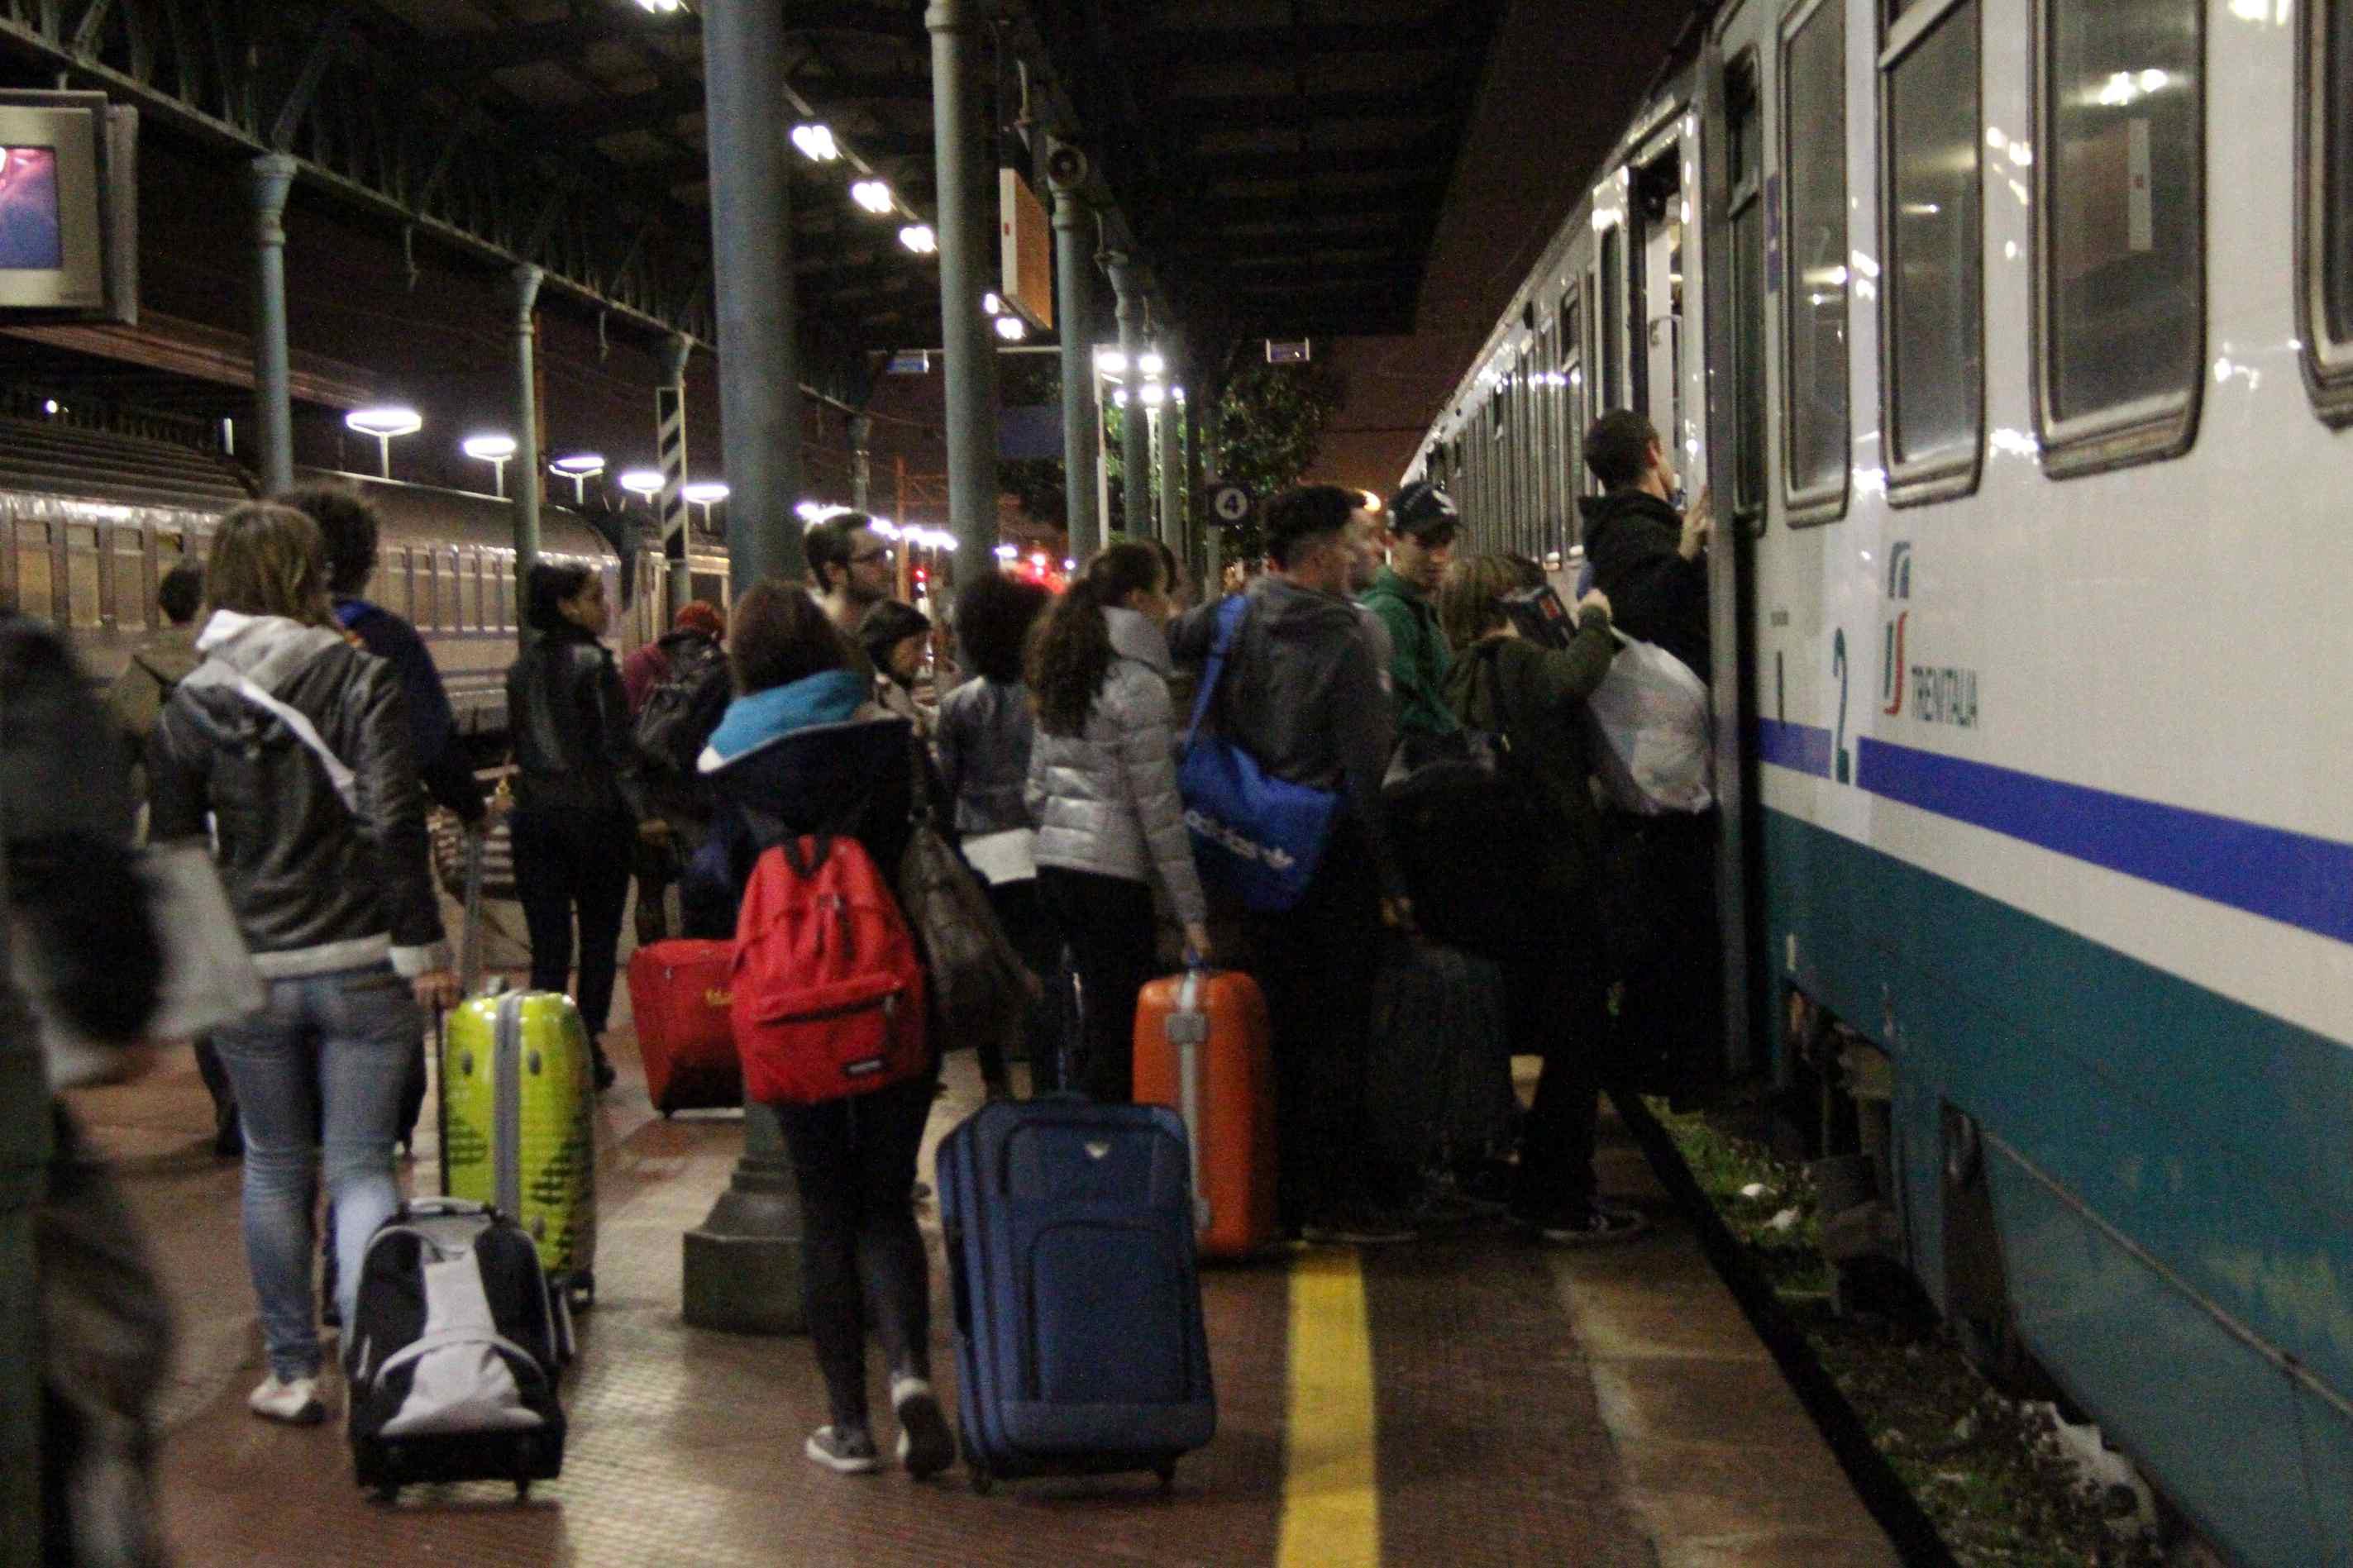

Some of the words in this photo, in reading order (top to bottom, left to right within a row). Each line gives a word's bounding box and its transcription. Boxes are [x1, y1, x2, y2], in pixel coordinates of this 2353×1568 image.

[1223, 493, 1239, 514] 4
[1832, 627, 1850, 785] 2
[1912, 665, 1978, 729] TRENITALIA
